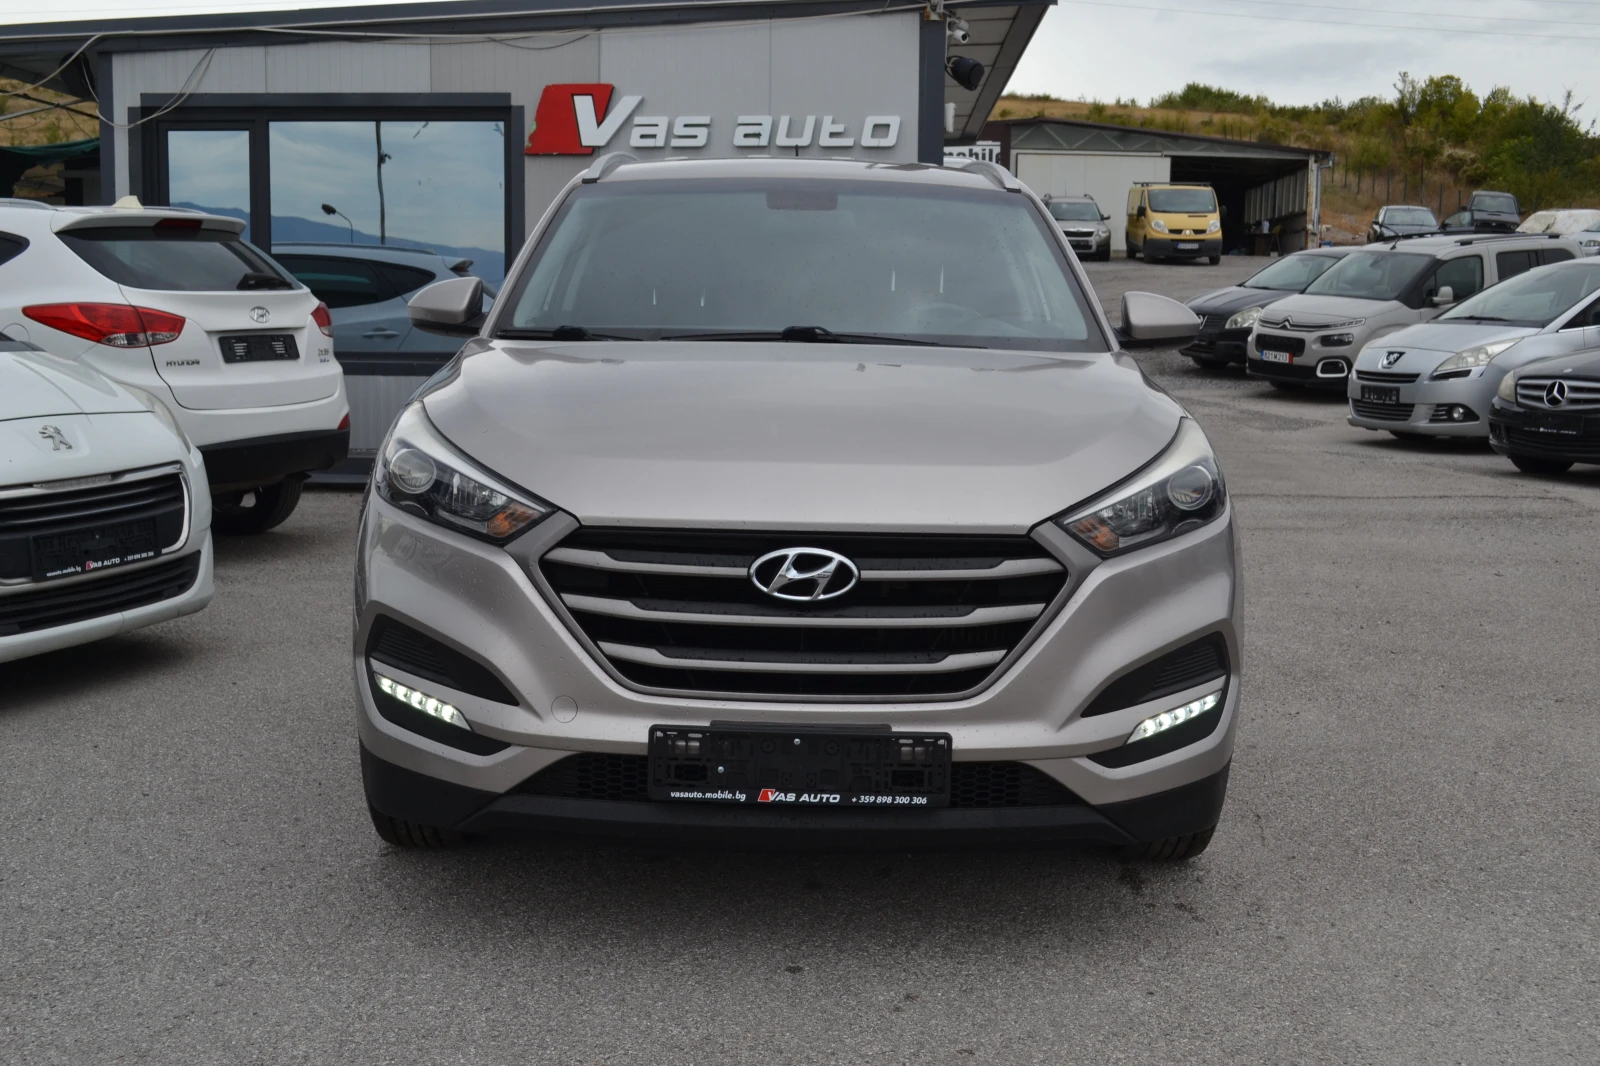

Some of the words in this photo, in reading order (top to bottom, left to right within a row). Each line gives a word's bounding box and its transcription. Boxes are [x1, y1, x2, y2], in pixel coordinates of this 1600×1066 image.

[572, 95, 712, 148] Vas
[732, 114, 901, 148] auto
[103, 557, 120, 566] AUTO
[670, 790, 746, 802] vasauto.mobile.bg
[768, 792, 796, 802] VAS
[799, 794, 840, 803] AUTO
[876, 796, 892, 804] 898
[894, 796, 910, 804] 300
[911, 796, 927, 804] 306
